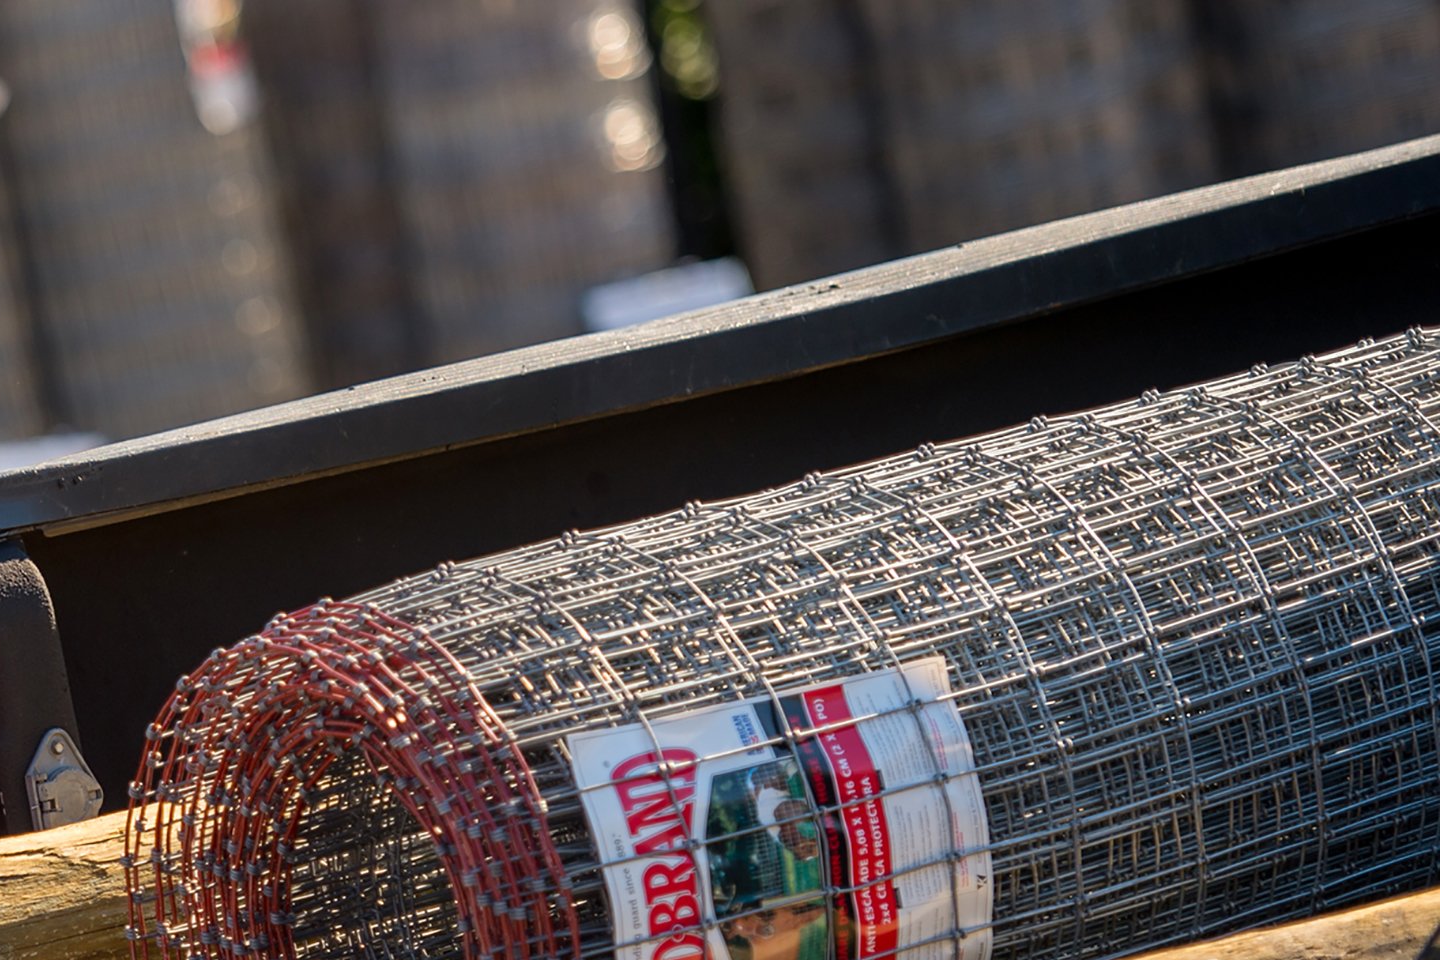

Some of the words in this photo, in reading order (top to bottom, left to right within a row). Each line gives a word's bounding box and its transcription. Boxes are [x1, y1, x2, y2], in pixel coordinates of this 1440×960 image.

[838, 758, 852, 778] CM
[624, 868, 636, 895] since
[874, 859, 888, 899] CECA
[628, 898, 642, 929] guard
[859, 858, 876, 953] ANTI-ESCAADE
